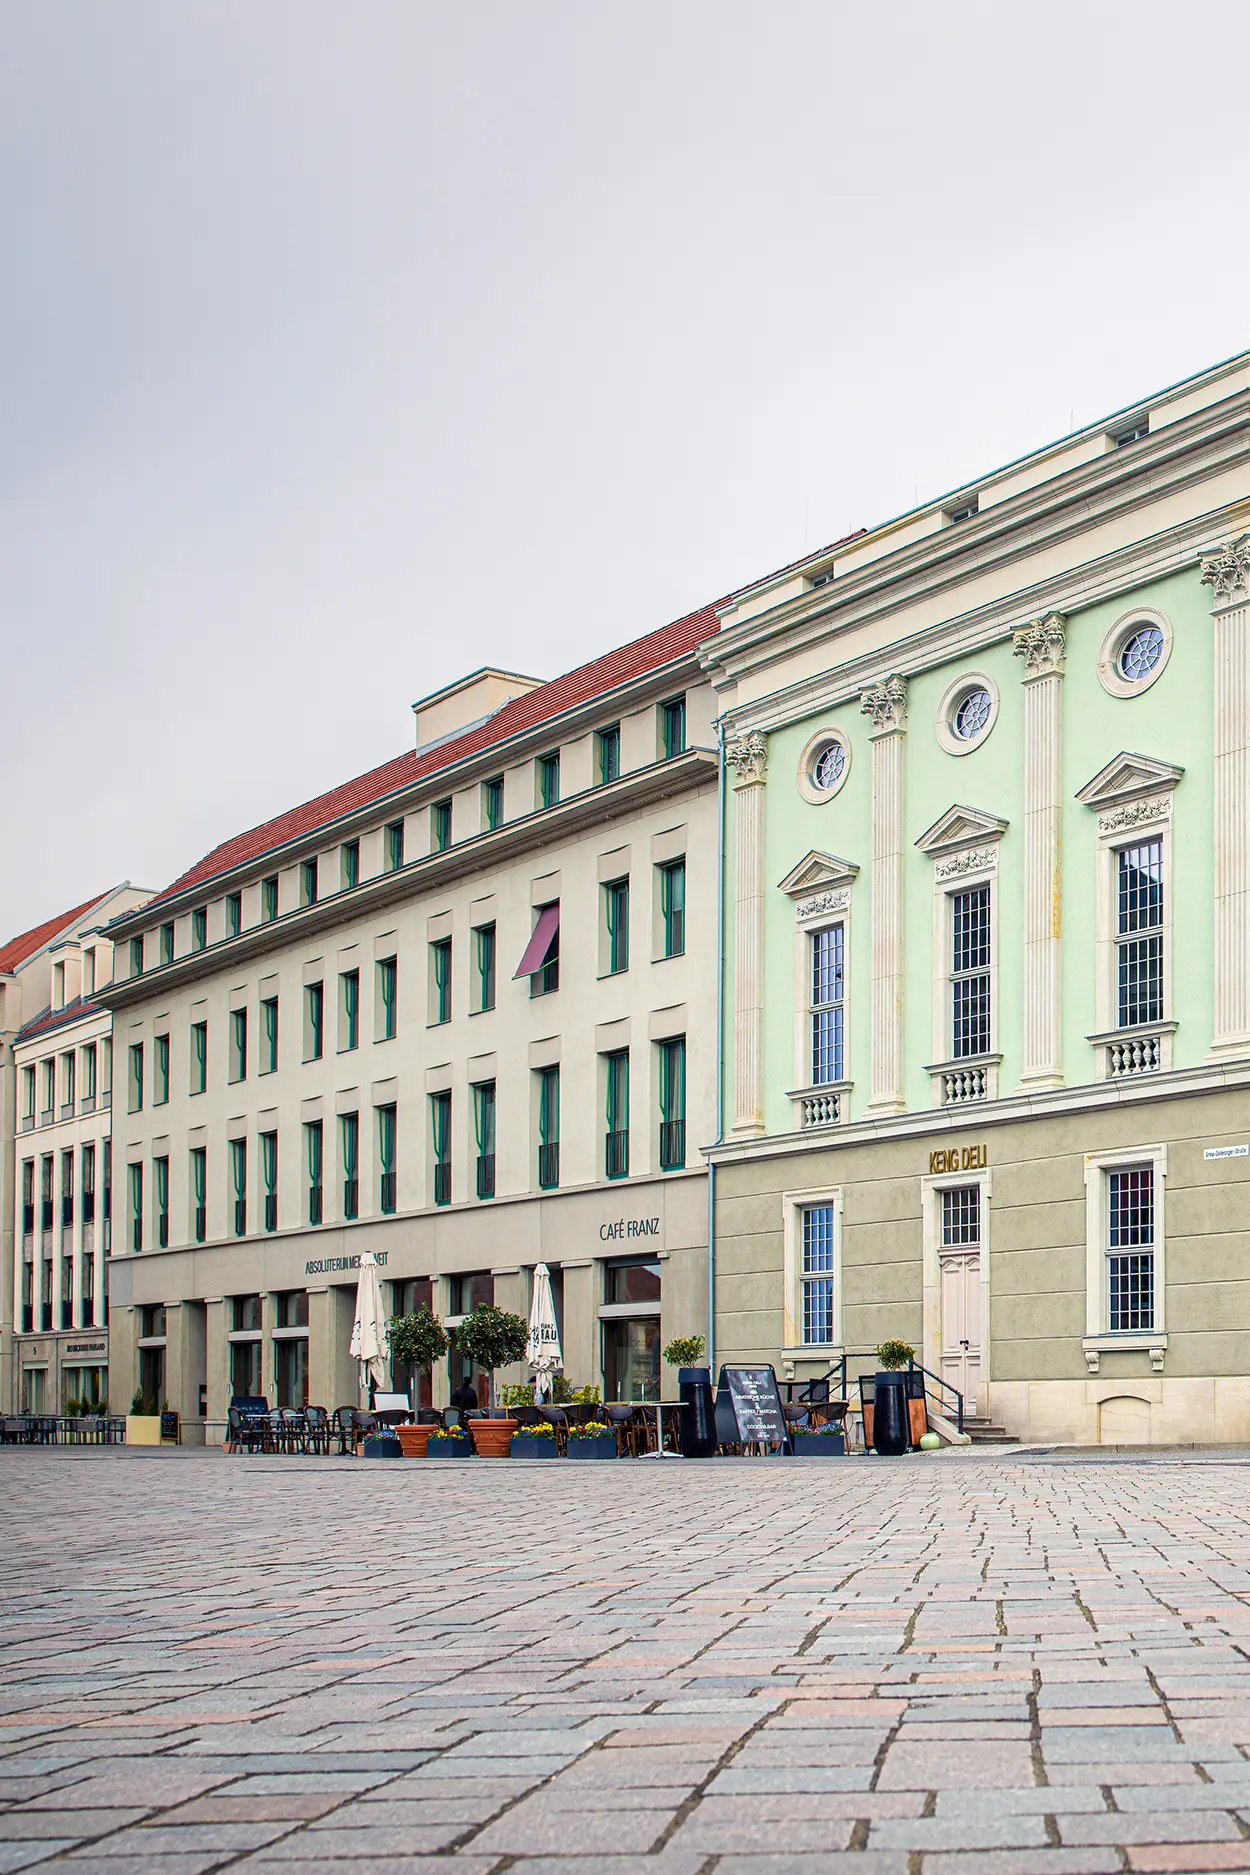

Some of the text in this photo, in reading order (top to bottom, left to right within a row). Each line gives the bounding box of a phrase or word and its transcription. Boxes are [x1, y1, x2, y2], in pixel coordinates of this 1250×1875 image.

[929, 1144, 987, 1174] KENG DELI
[599, 1217, 660, 1241] CAFÉ FRANZ
